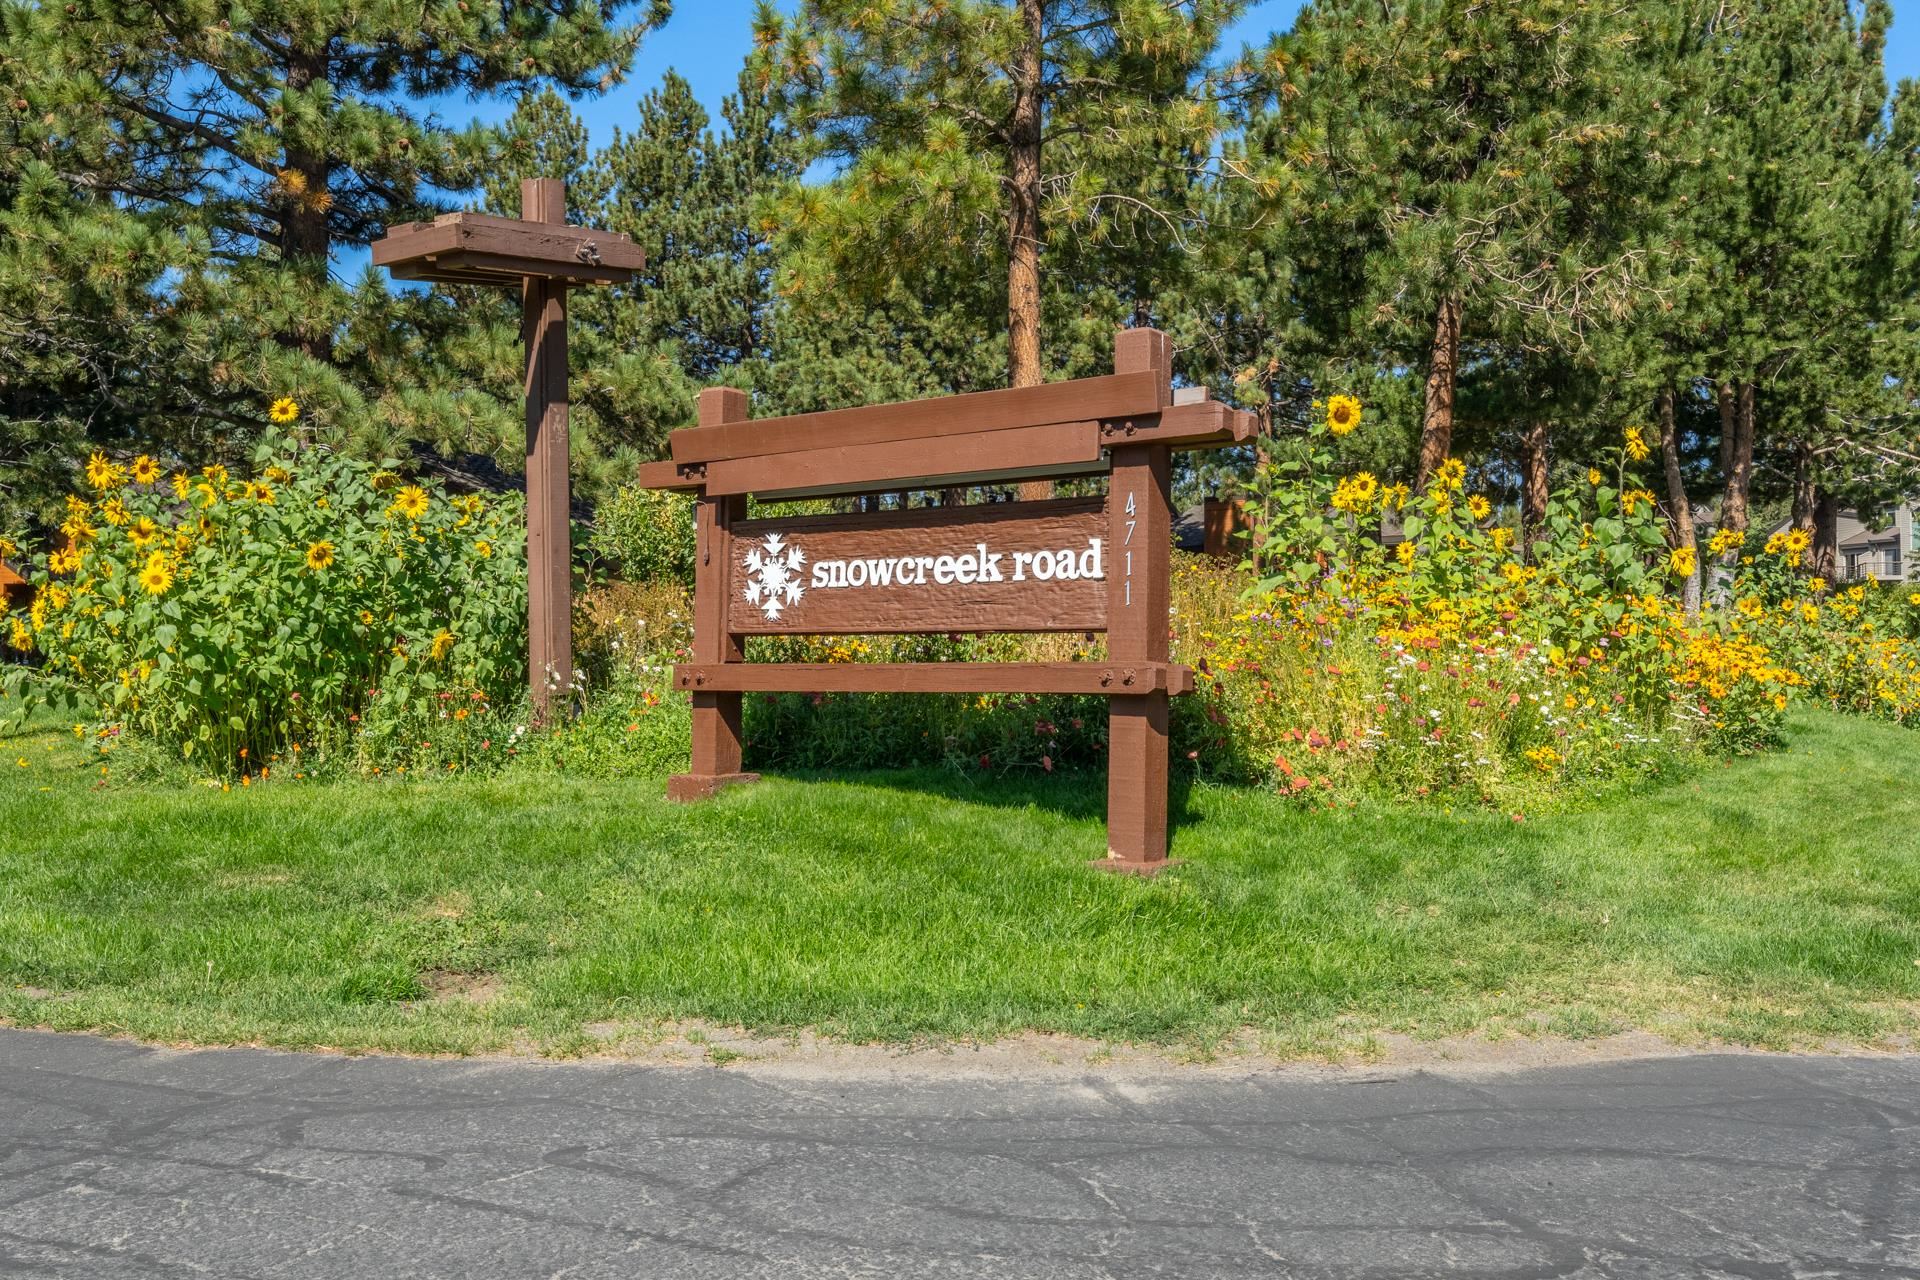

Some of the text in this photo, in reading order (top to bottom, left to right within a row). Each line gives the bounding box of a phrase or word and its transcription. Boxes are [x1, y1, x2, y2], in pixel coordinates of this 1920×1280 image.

[811, 537, 1104, 588] snowcreek road
[1124, 491, 1136, 607] 4711
